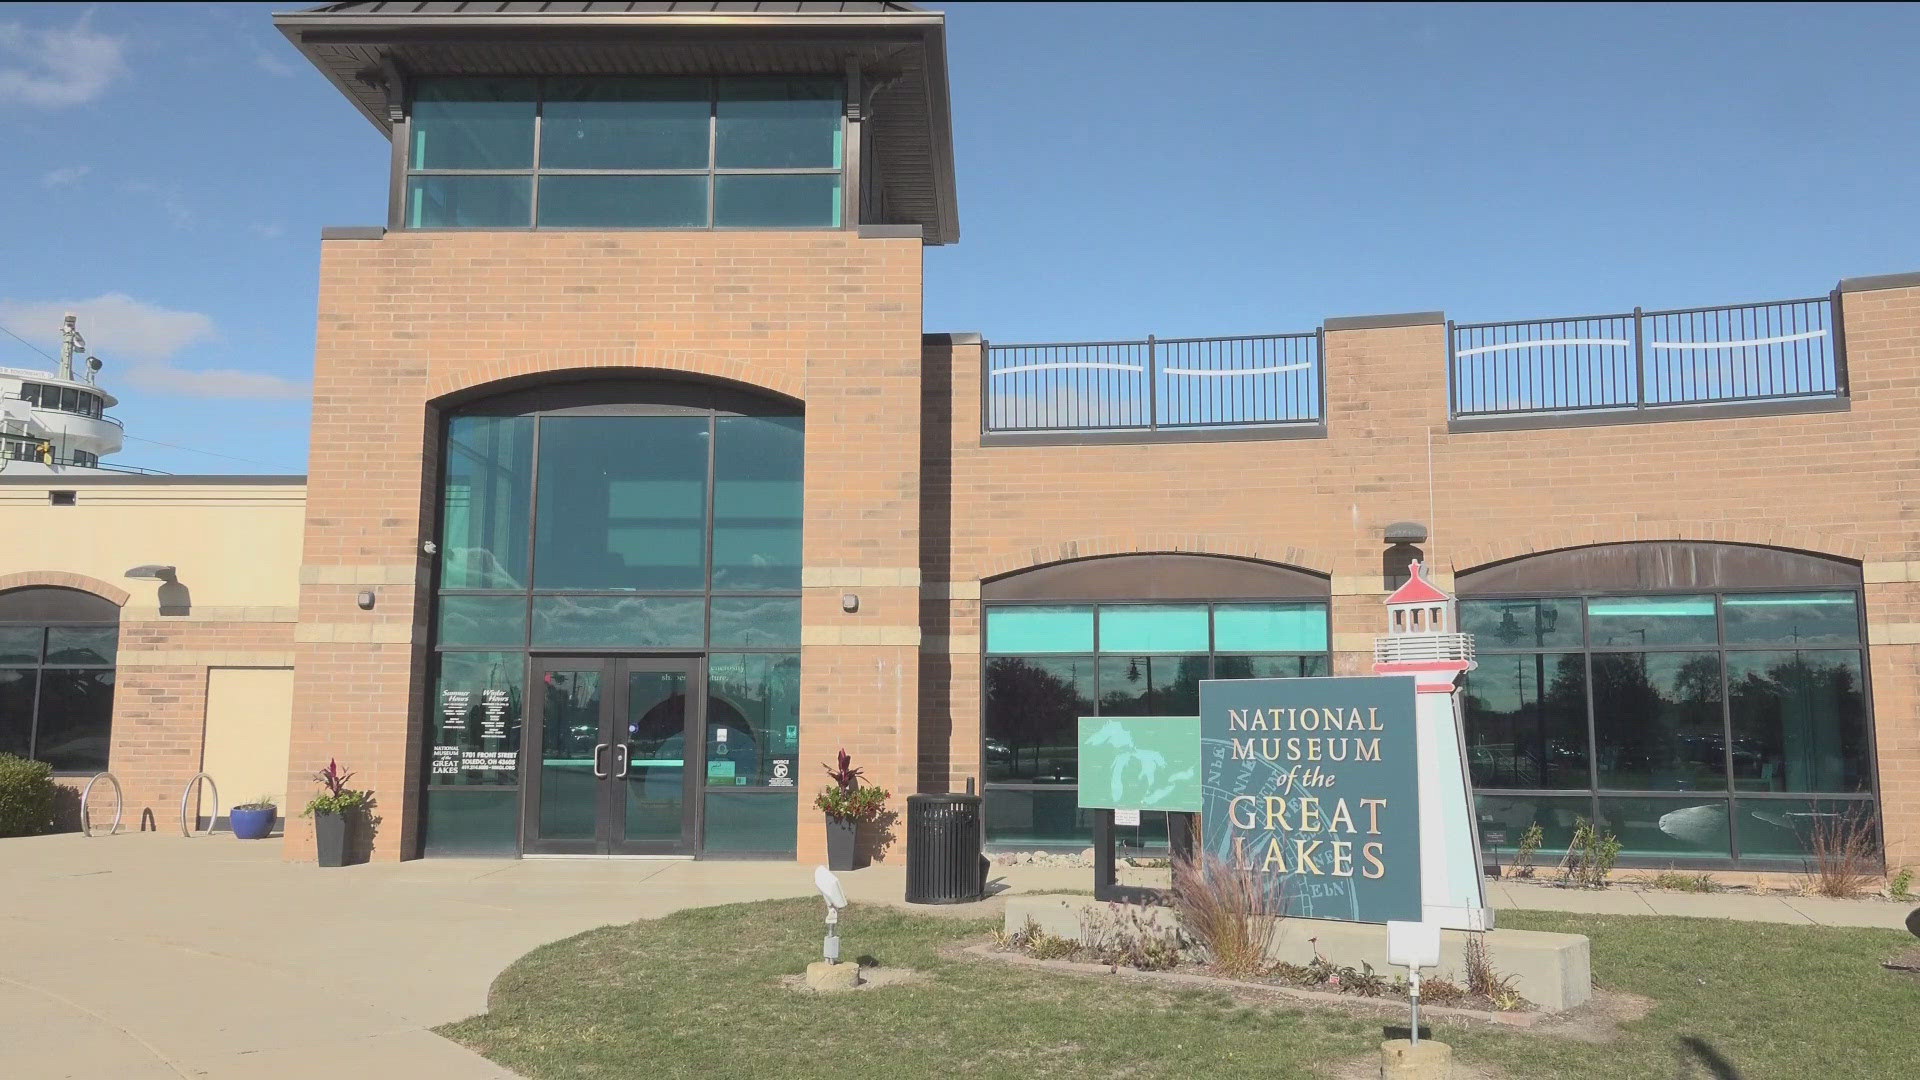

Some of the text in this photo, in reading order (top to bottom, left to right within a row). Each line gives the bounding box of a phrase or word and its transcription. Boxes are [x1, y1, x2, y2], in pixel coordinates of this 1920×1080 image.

[711, 664, 745, 673] enerosity
[1227, 707, 1384, 731] NATIONAL
[1231, 737, 1382, 761] MUSEUM
[1276, 765, 1336, 795] of the
[1228, 795, 1387, 835] GREAT
[1233, 837, 1386, 879] LAKES
